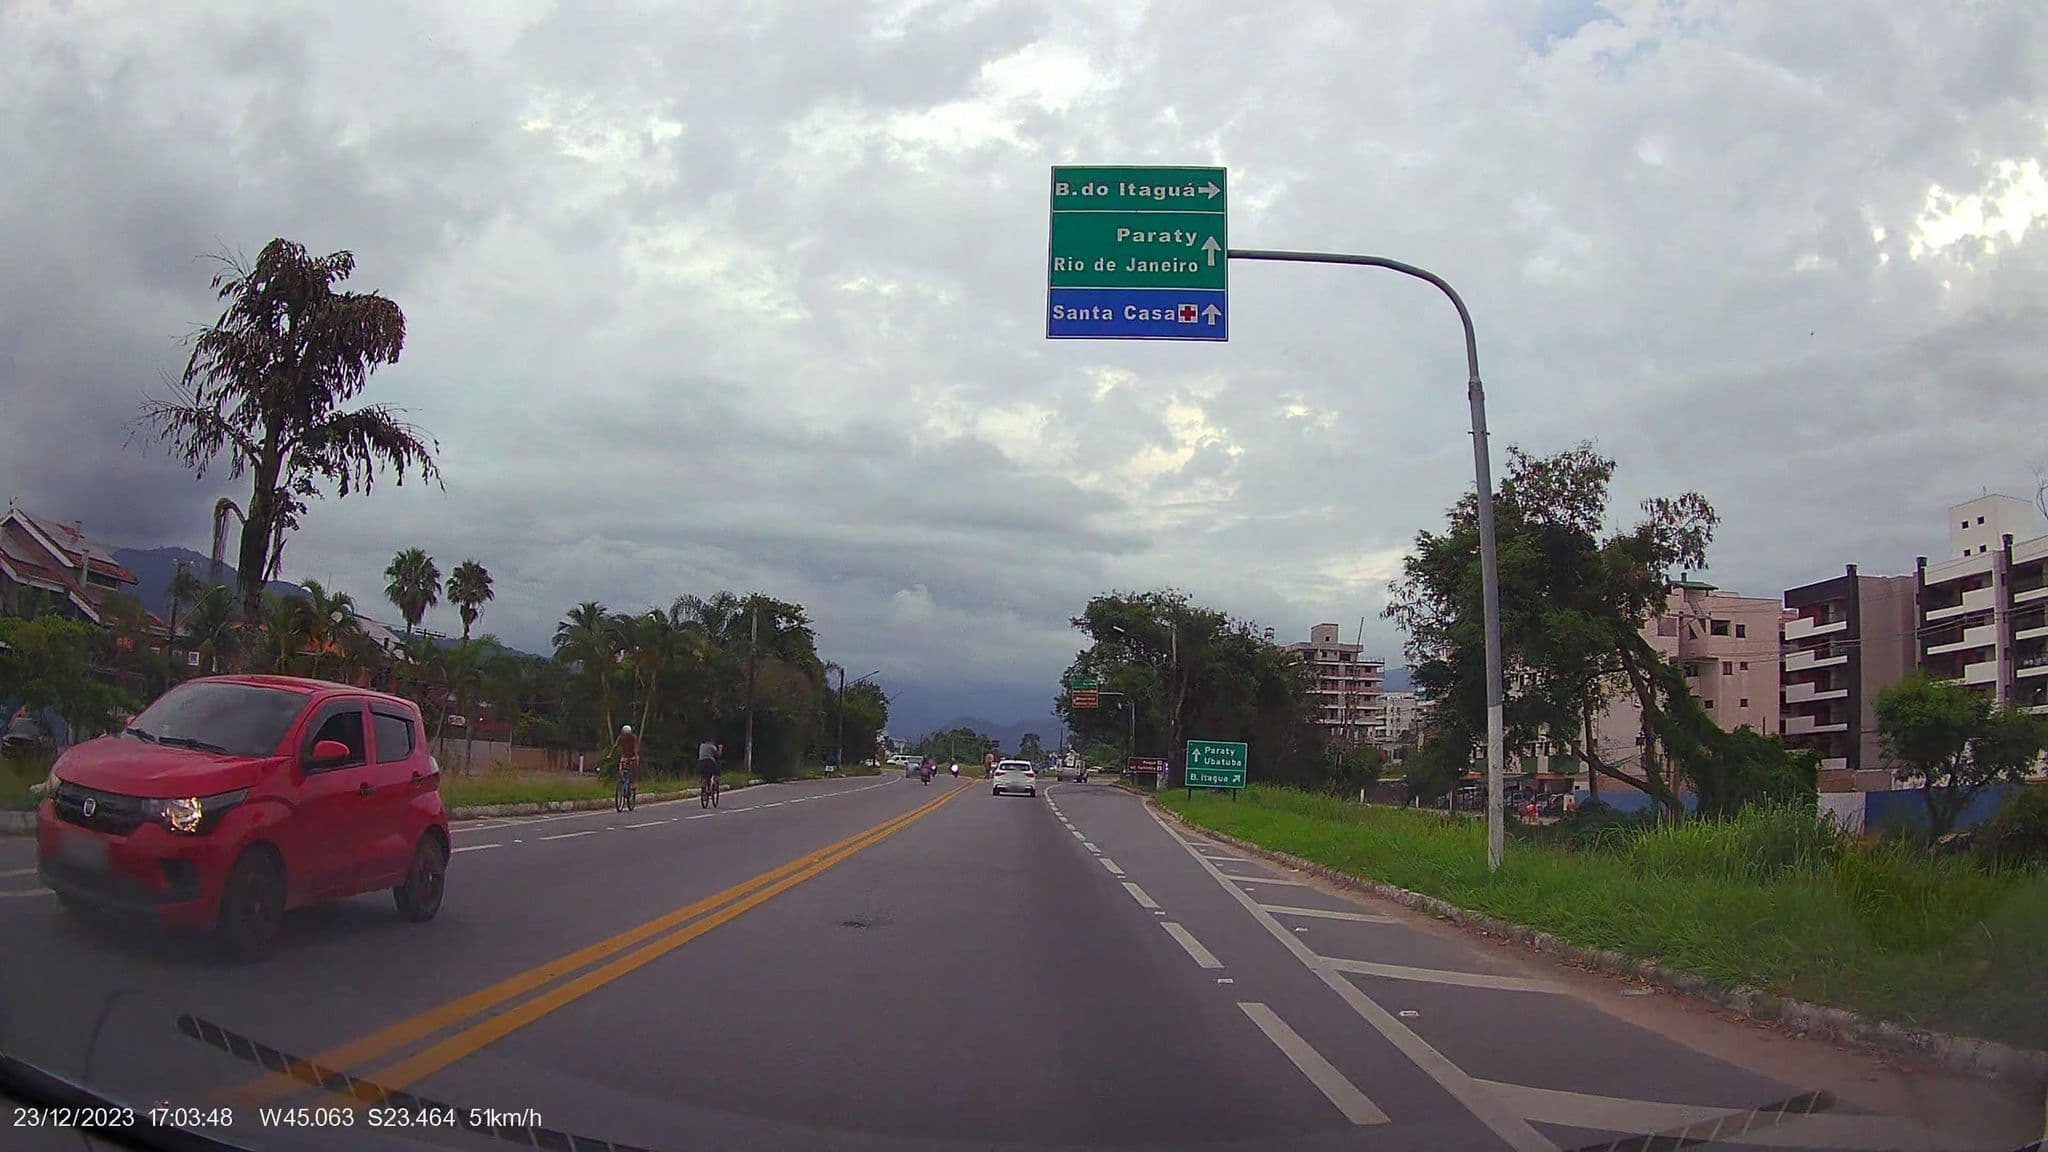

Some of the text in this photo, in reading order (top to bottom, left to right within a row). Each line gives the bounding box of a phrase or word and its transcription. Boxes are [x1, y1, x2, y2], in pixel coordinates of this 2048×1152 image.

[1055, 182, 1196, 200] B.do Itaguá
[1117, 228, 1197, 246] Paraty
[1054, 257, 1198, 273] Rio de Janeiro
[1053, 305, 1175, 320] Santa Casa
[1204, 746, 1236, 756] Paraty
[1204, 757, 1242, 766] Ubatuba
